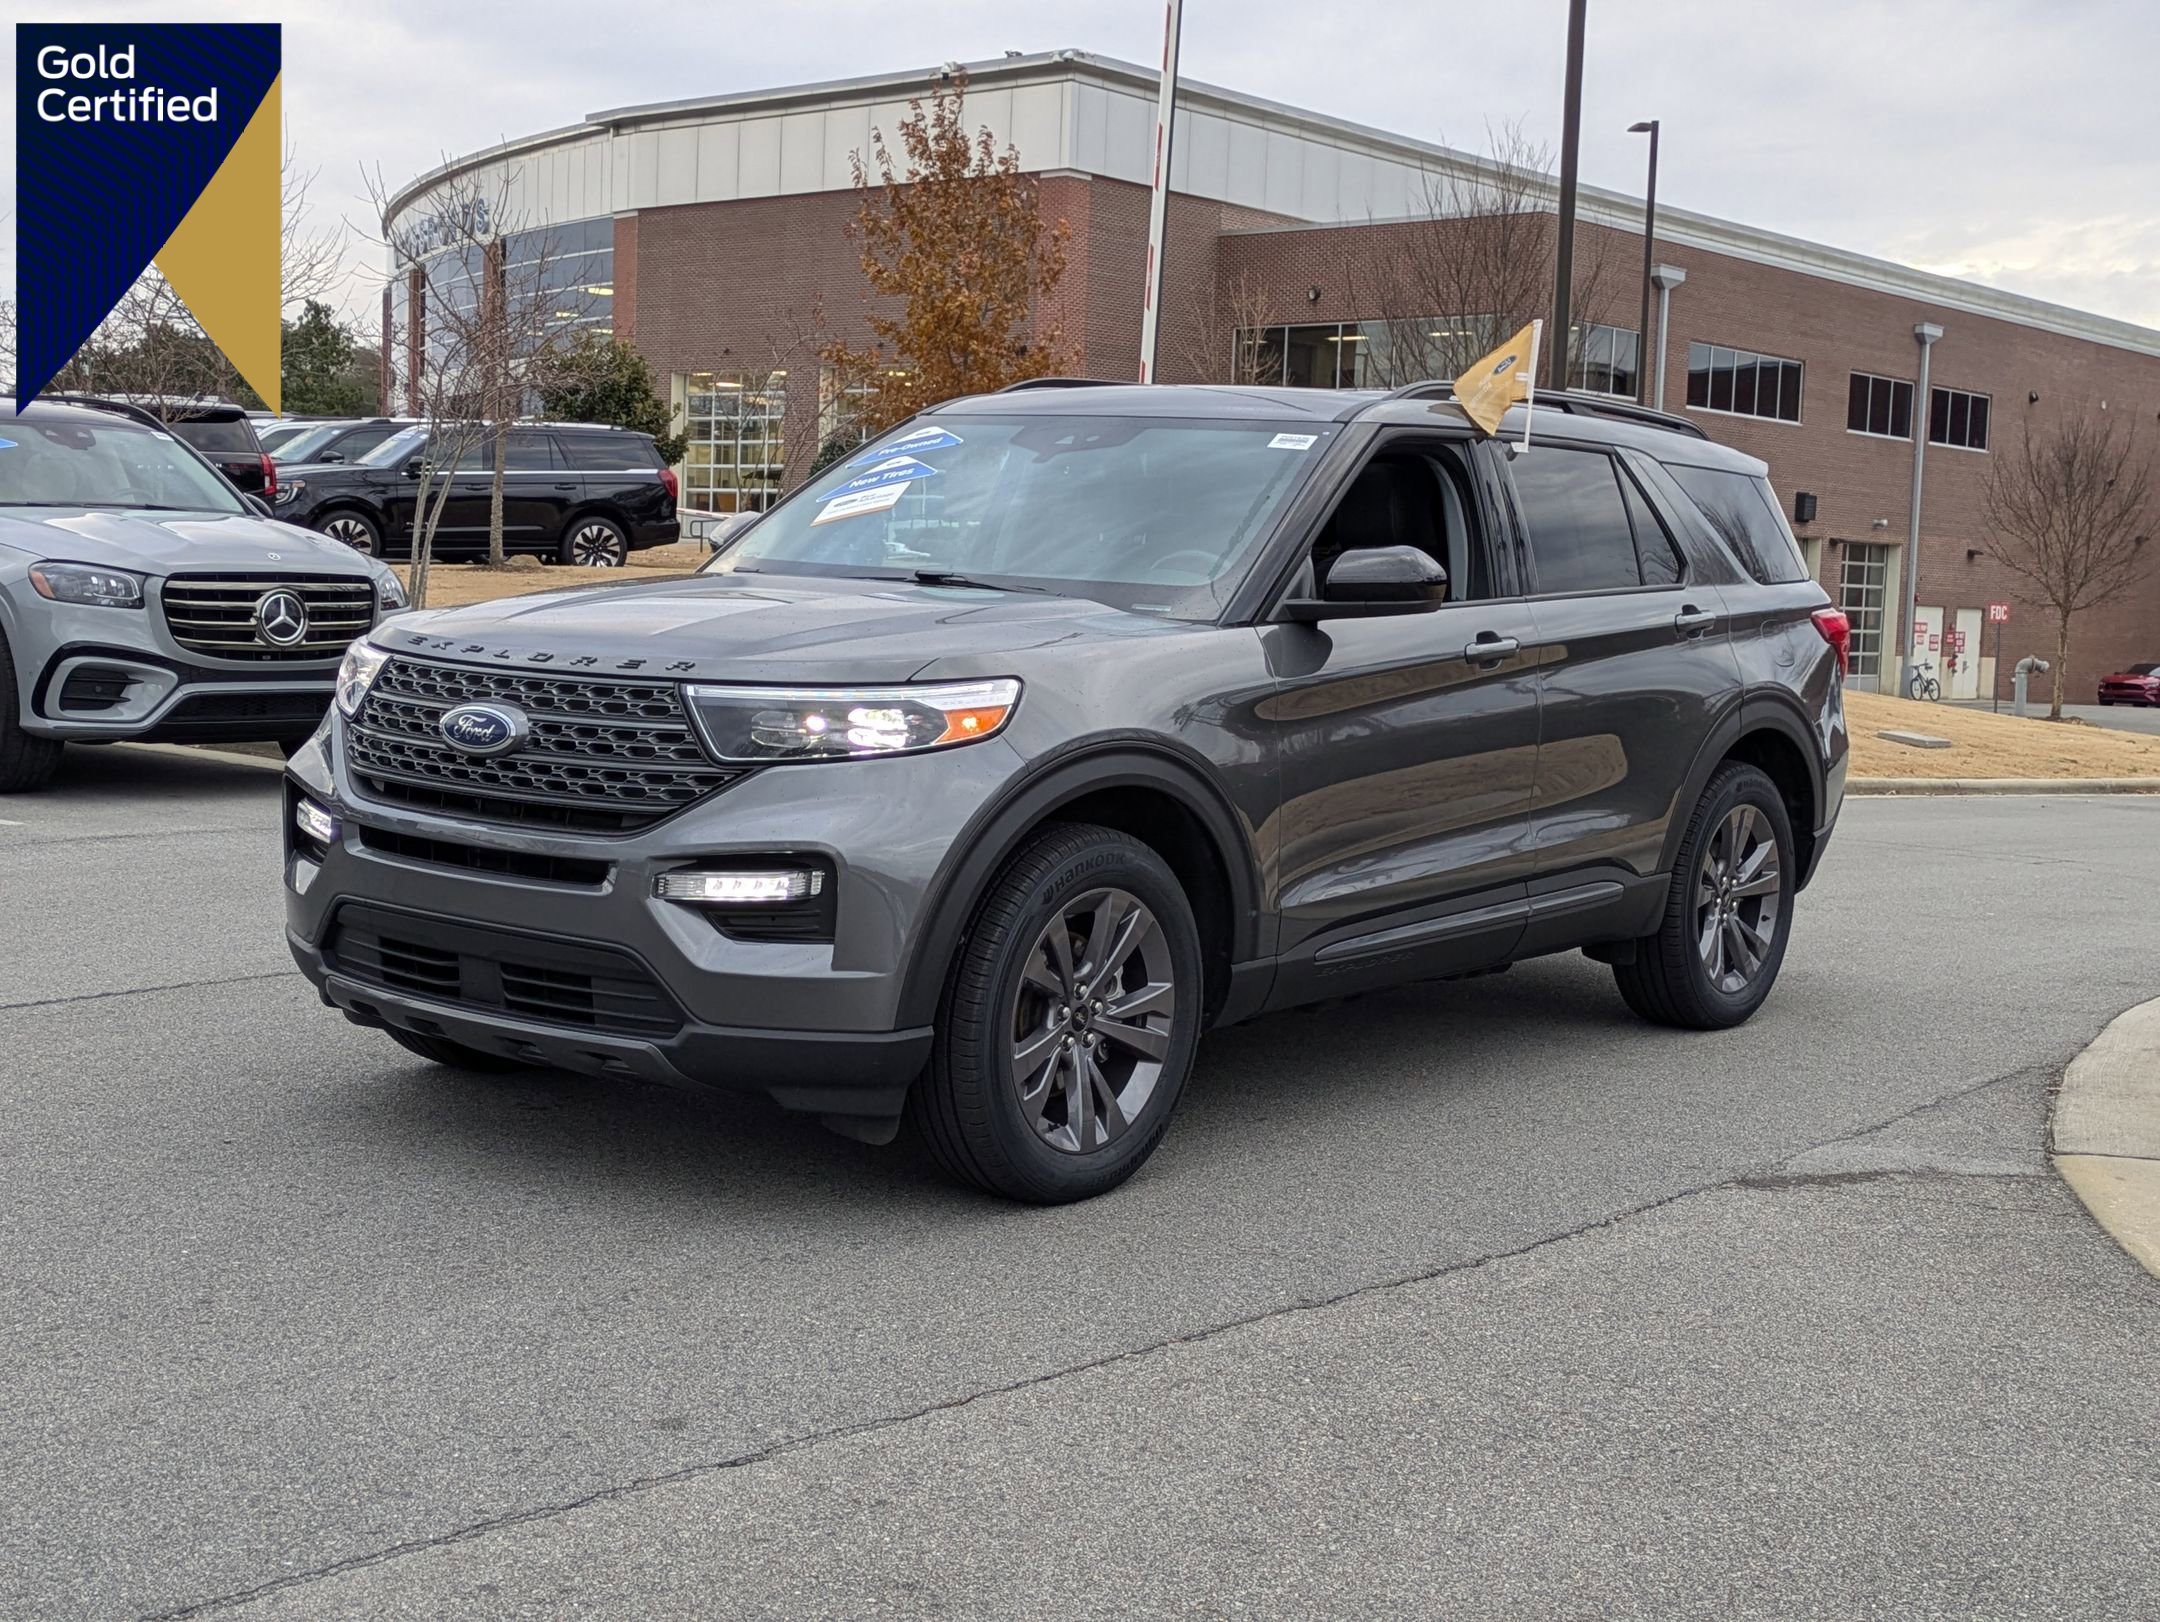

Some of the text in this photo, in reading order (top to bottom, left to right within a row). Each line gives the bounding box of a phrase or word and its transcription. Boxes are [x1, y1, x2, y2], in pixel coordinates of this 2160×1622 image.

[878, 437, 944, 456] Pre-Owned
[849, 468, 915, 488] New Tires
[1990, 605, 2008, 620] FDC
[407, 635, 696, 672] EXPLORER
[453, 714, 496, 739] Ford
